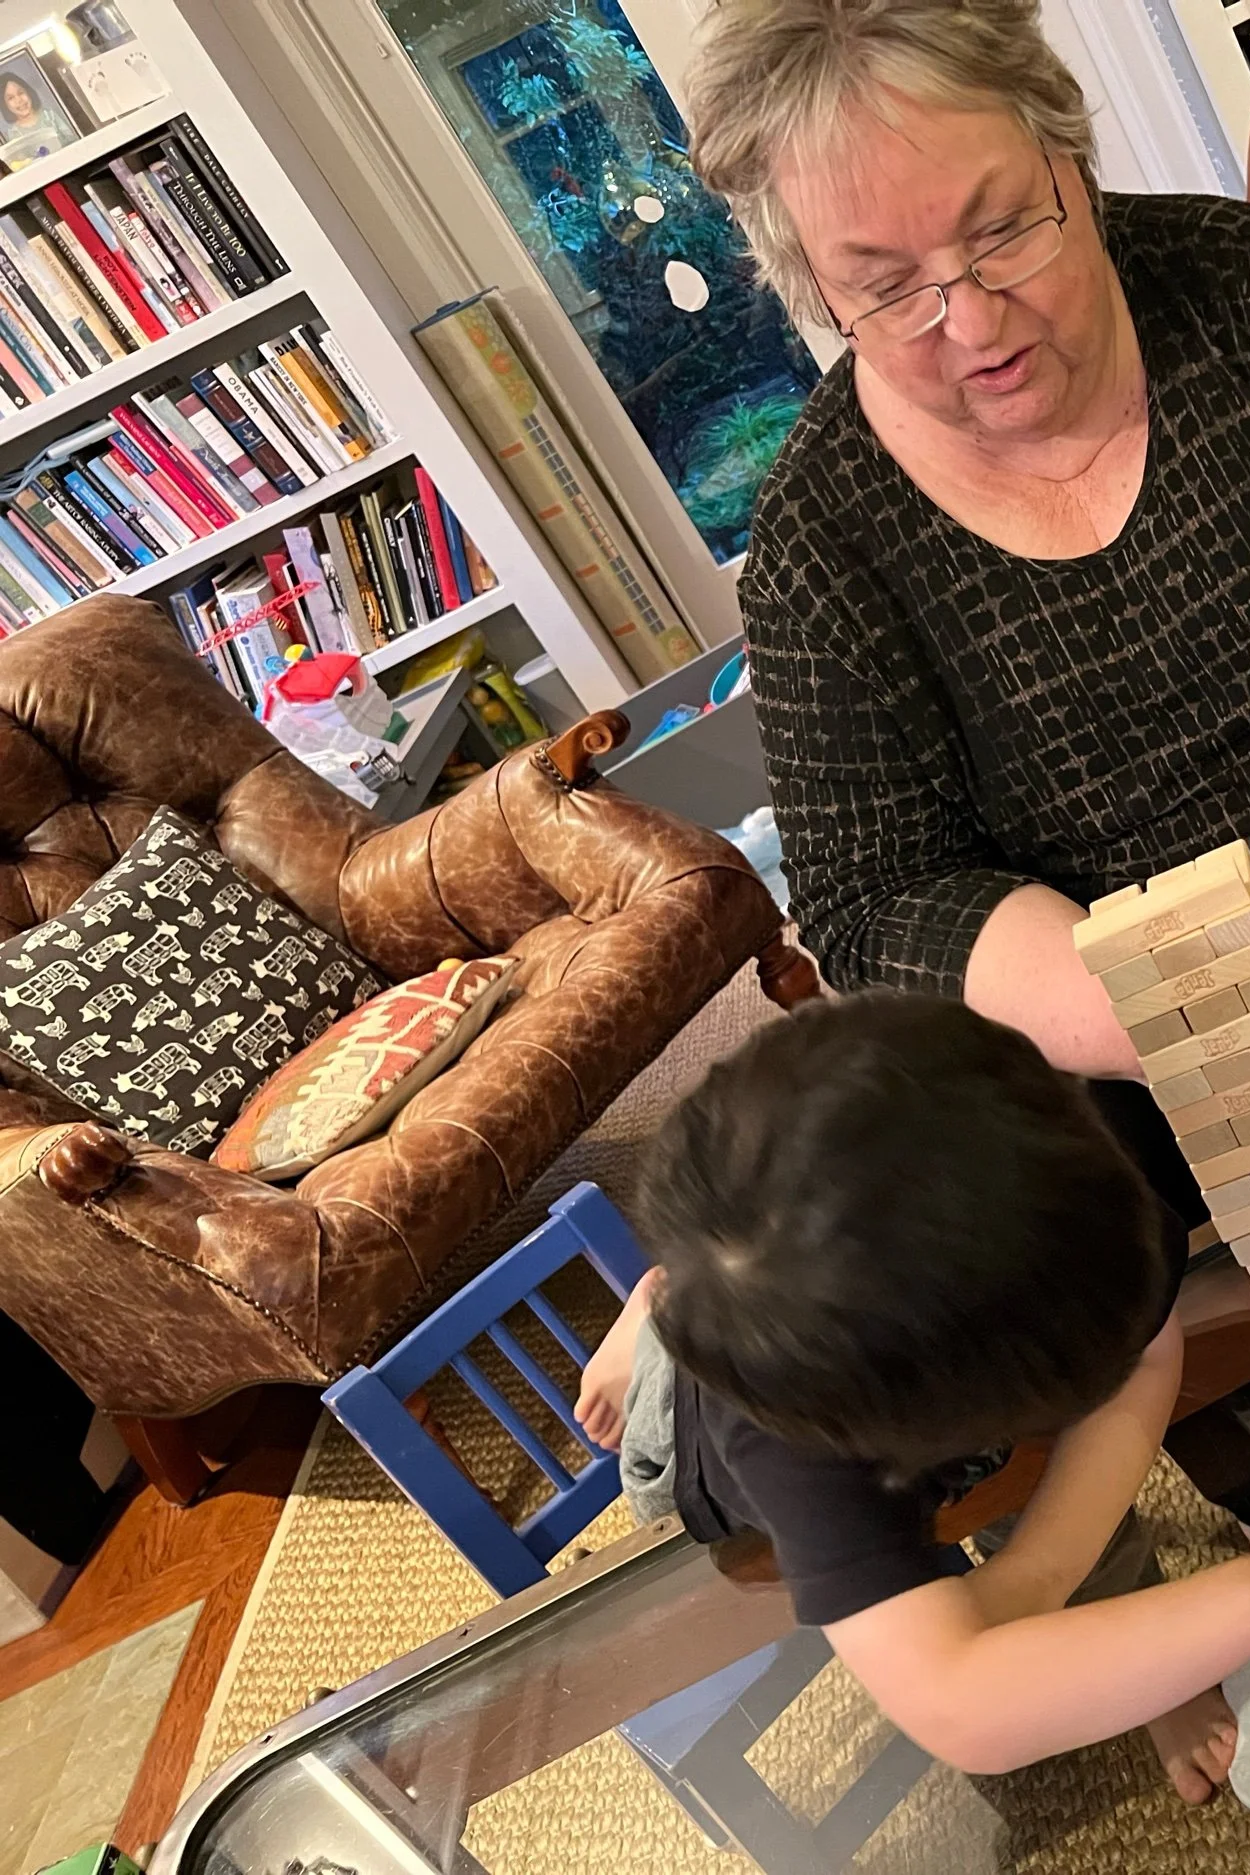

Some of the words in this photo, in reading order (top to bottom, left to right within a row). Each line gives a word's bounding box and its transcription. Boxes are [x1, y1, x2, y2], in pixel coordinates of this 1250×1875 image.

[182, 121, 199, 144] FIRE
[203, 153, 222, 179] DALE
[114, 211, 138, 241] JAPAN
[171, 181, 207, 230] THROUGH
[204, 228, 222, 250] THE
[217, 249, 237, 273] LENS
[102, 255, 117, 273] ROY
[228, 236, 246, 258] 100
[227, 375, 259, 414] OBAMA
